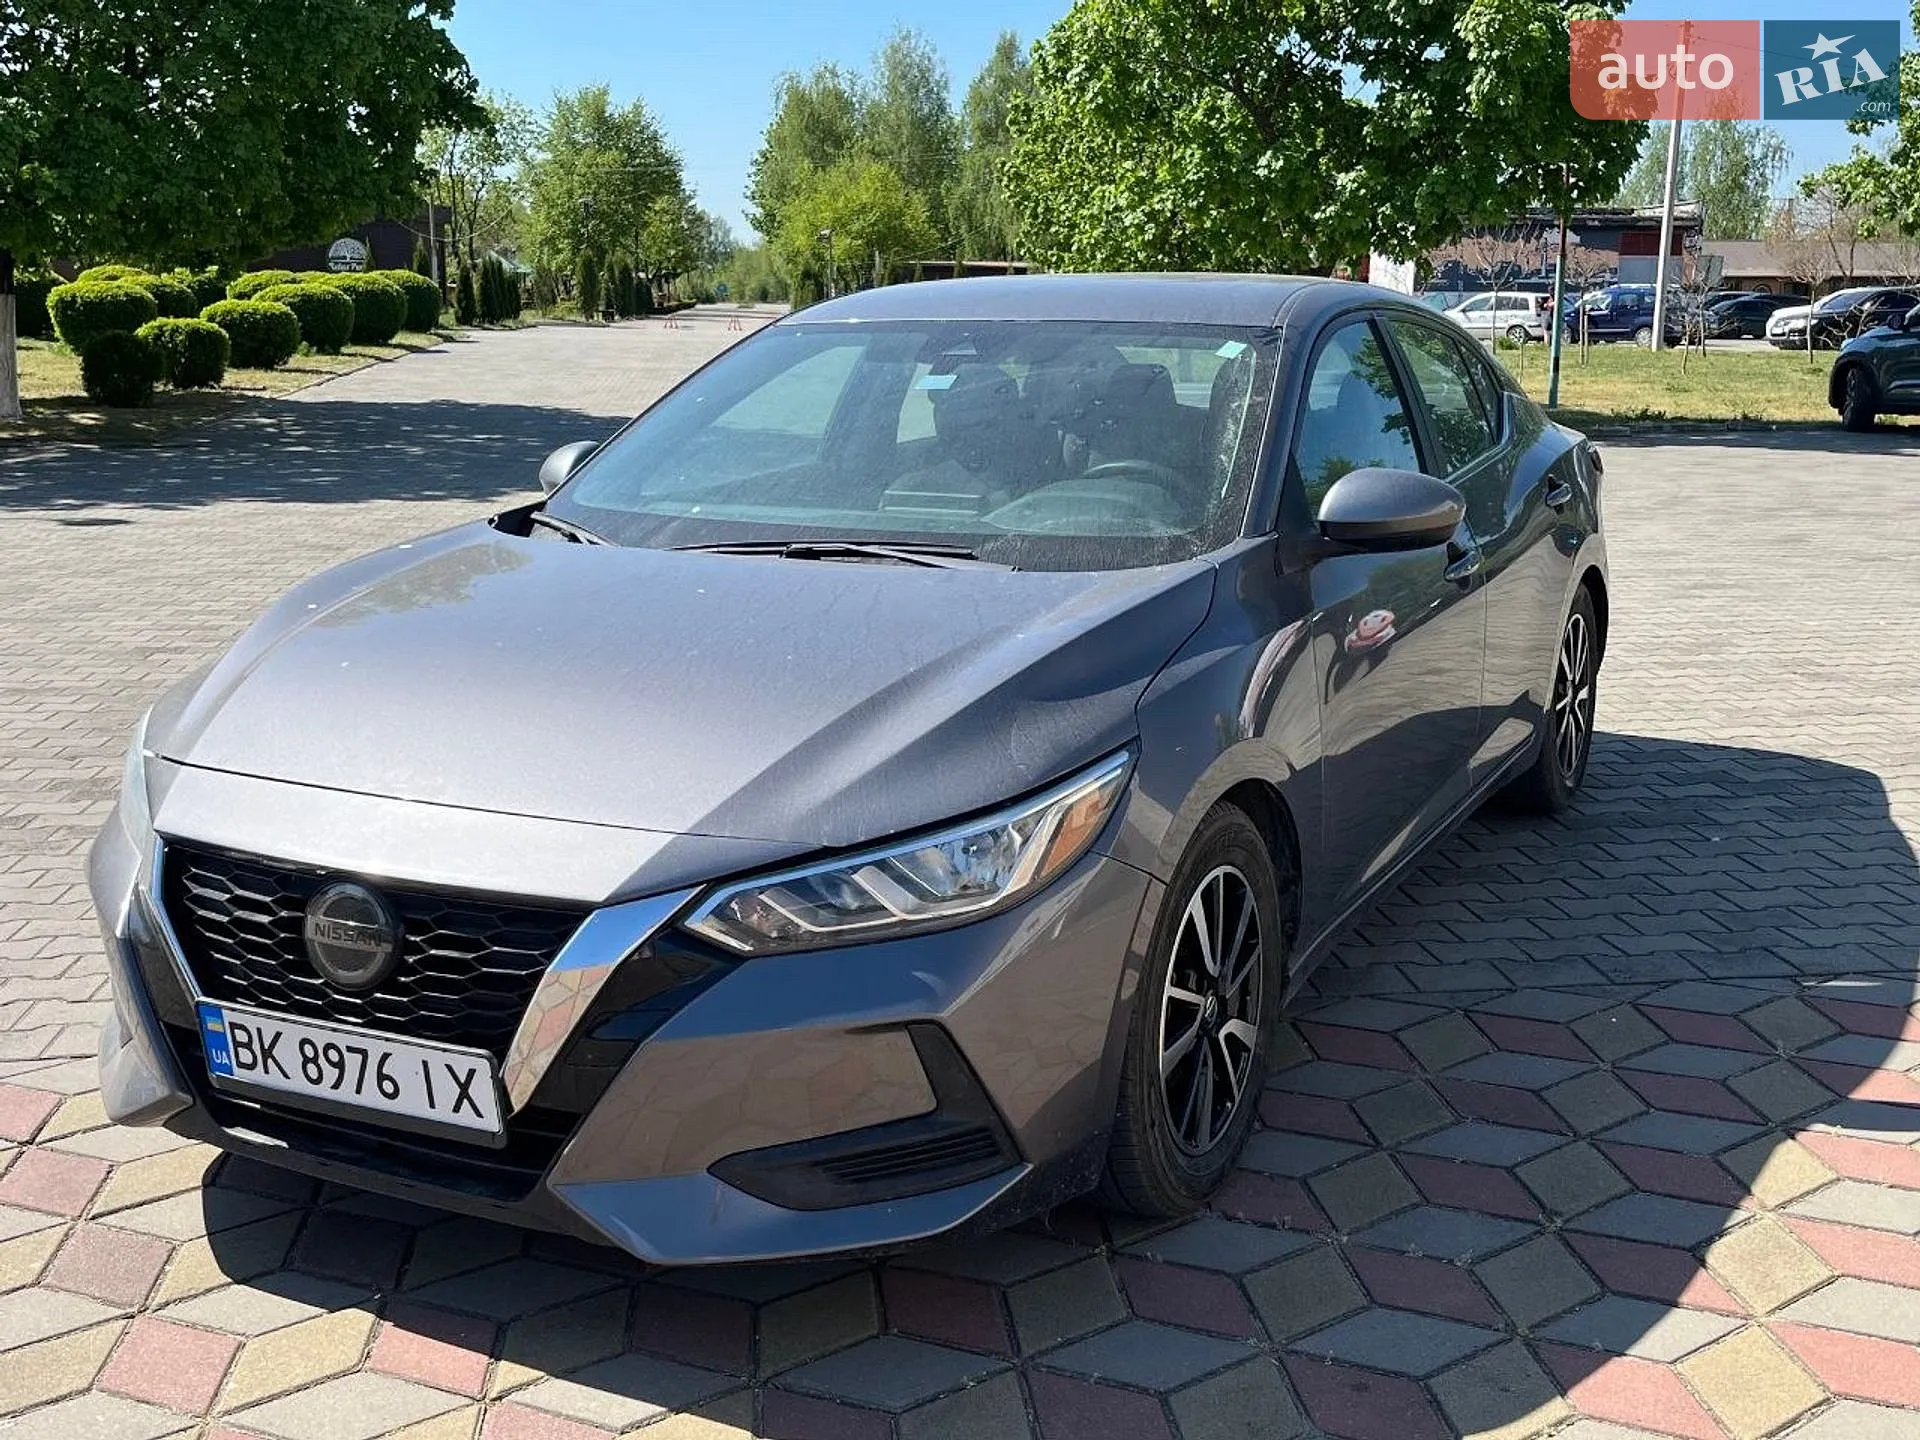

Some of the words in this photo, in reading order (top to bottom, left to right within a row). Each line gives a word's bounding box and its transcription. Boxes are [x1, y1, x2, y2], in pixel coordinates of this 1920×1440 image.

[315, 922, 380, 947] NISSAN
[212, 1048, 230, 1066] UA
[228, 1021, 291, 1080] BK
[299, 1038, 400, 1101] 8976
[421, 1059, 485, 1119] IX
